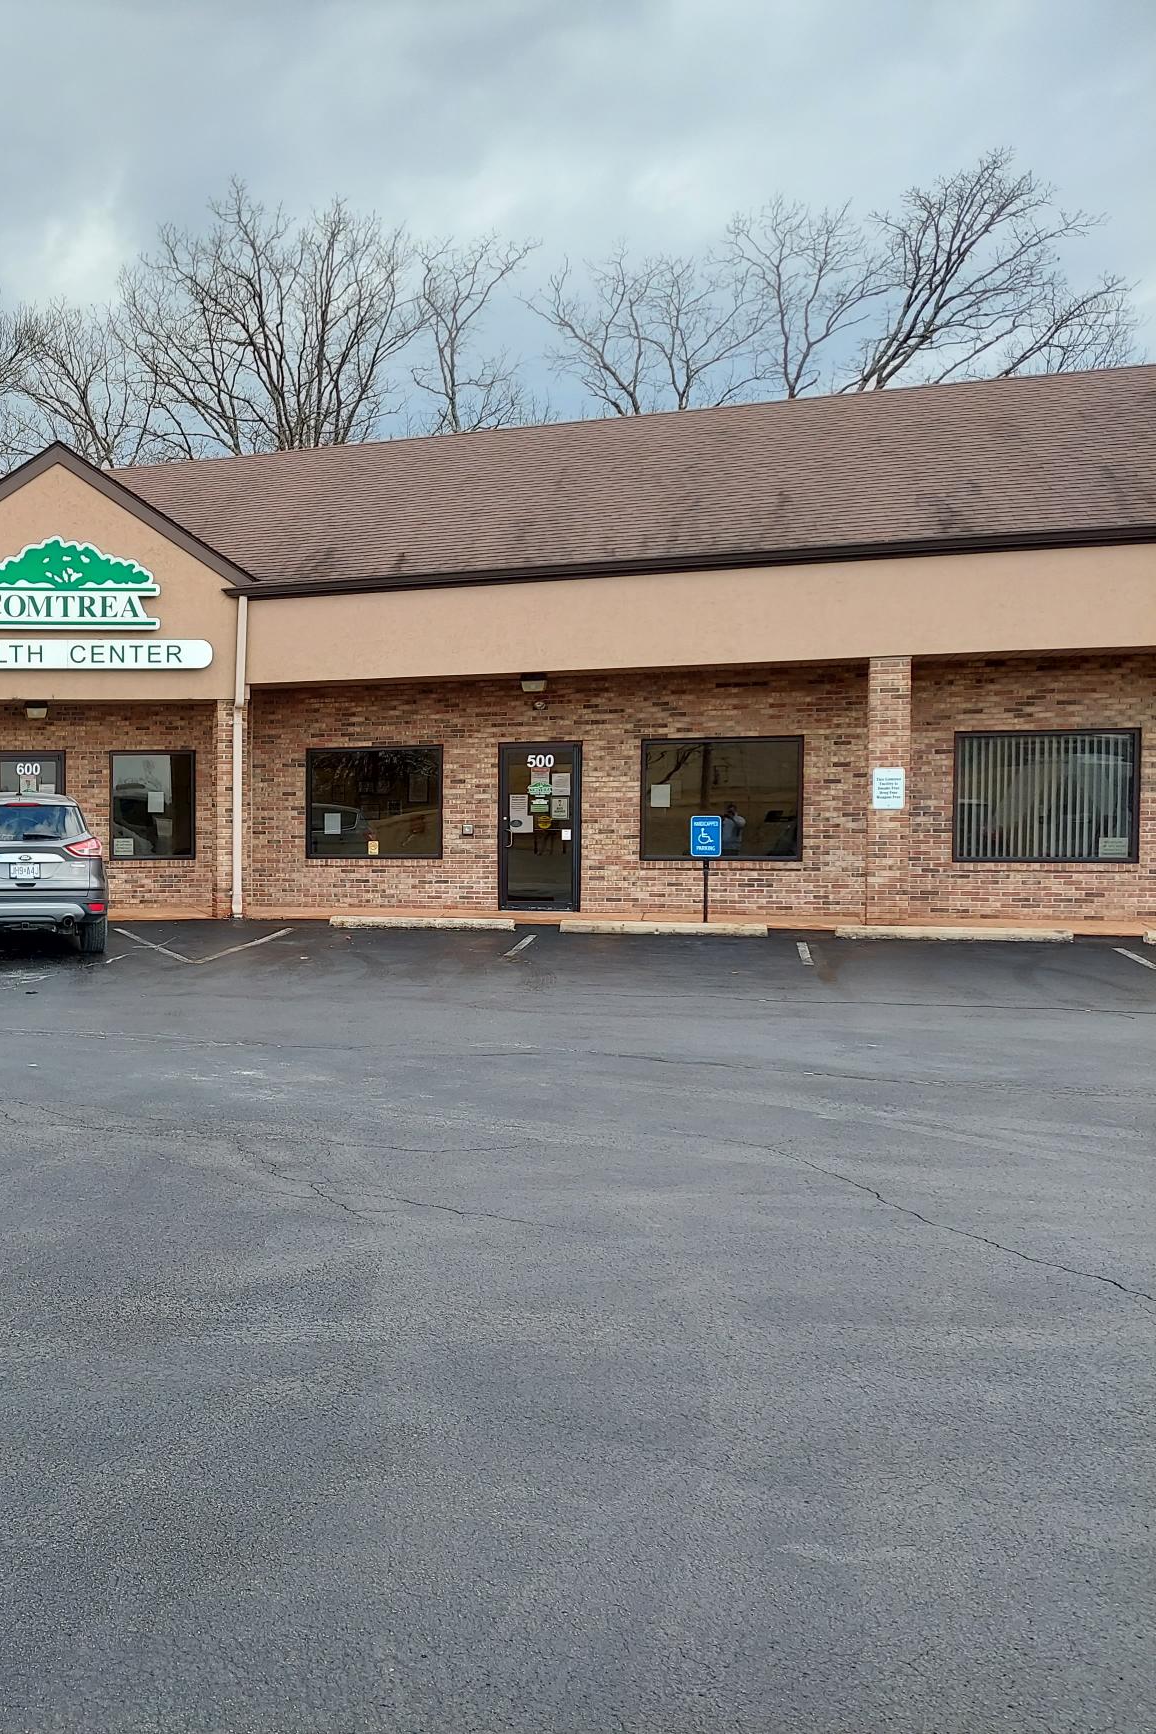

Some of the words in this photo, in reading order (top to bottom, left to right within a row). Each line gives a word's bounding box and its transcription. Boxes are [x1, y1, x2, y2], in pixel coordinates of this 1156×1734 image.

[69, 645, 183, 664] CENTER
[526, 754, 554, 768] 500
[16, 763, 41, 775] 600
